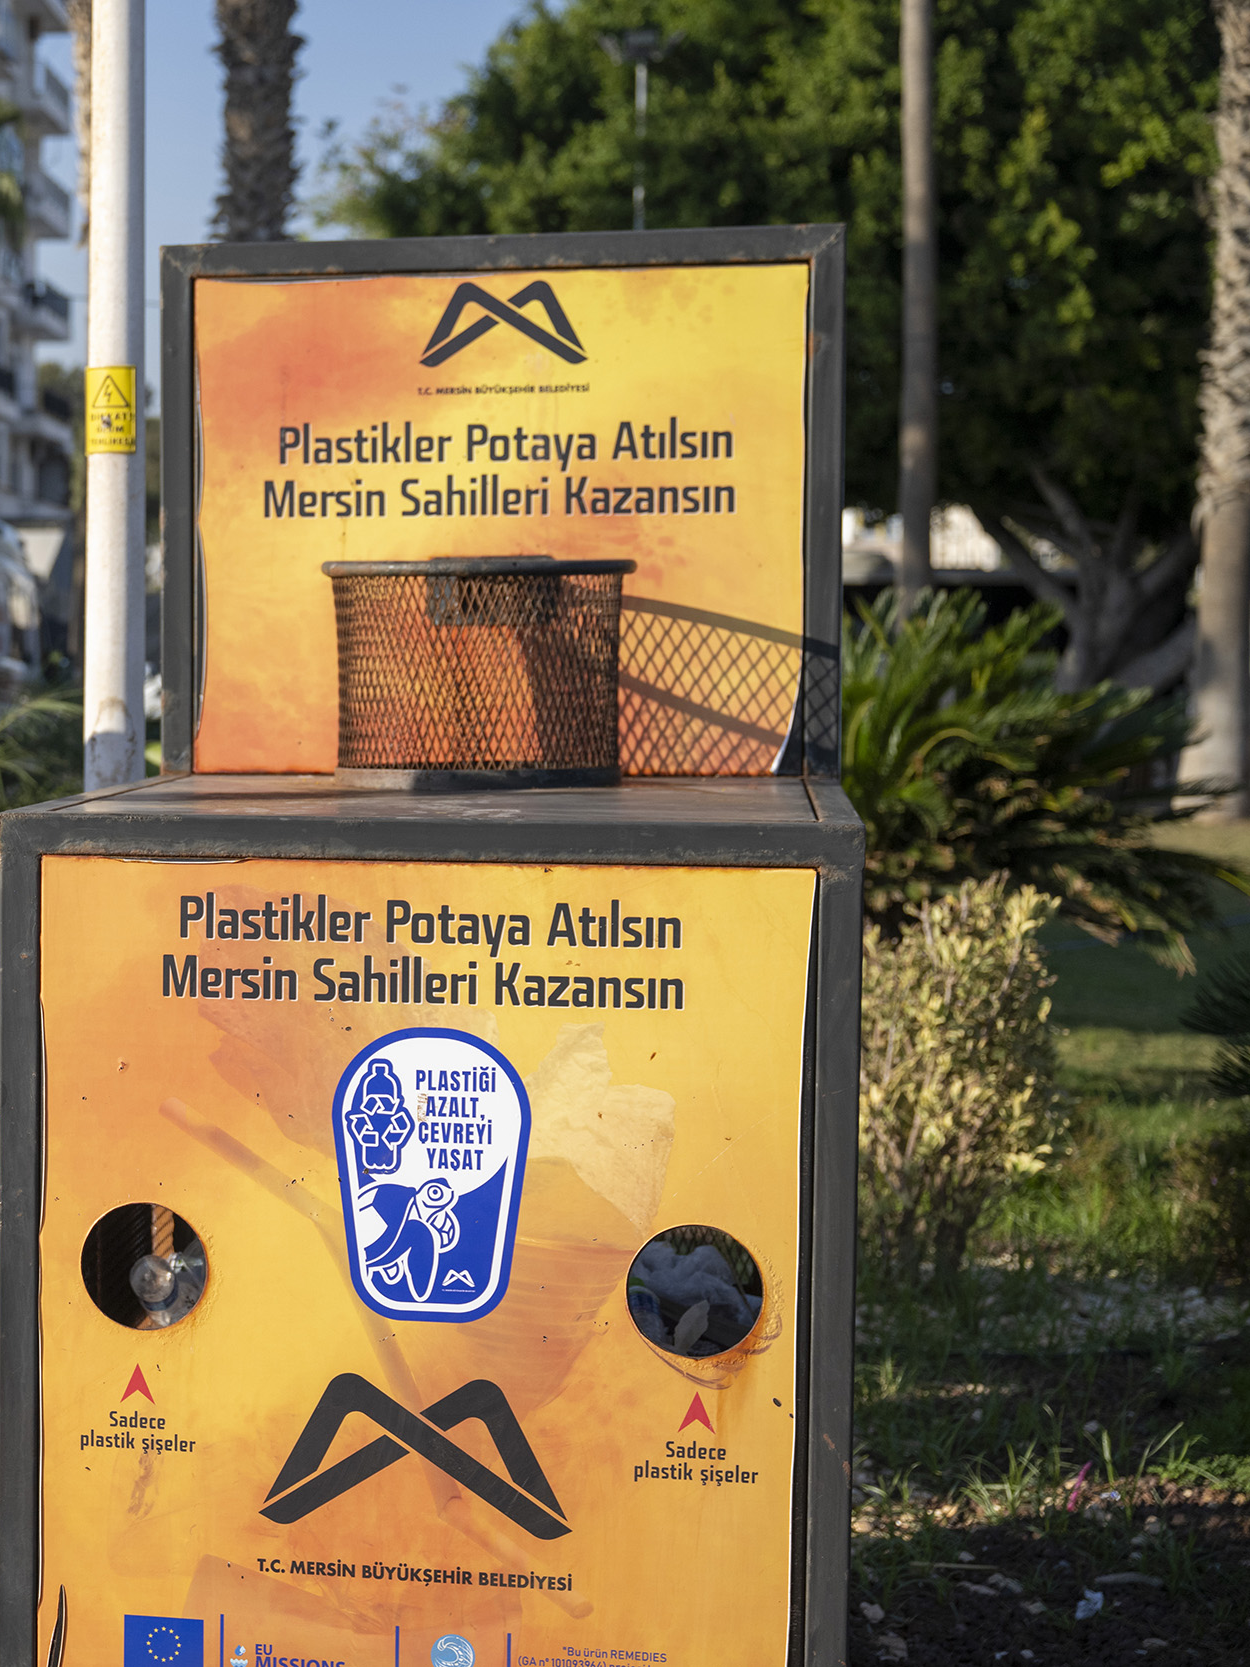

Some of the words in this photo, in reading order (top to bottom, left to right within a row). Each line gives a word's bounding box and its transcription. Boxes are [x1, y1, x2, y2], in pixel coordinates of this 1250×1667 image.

[417, 387, 432, 396] T.C.
[436, 385, 472, 395] MERSİN
[475, 383, 536, 396] BÜYÜKŞEHİR
[538, 381, 590, 393] BELEDİYESİ
[279, 421, 452, 465] Plastikler
[466, 423, 597, 472] Potaya
[611, 416, 734, 461] Atılsın
[263, 478, 386, 518] Mersin
[400, 473, 550, 518] Sahilleri
[564, 475, 736, 516] Kazansın
[179, 891, 372, 944] Plastikler
[386, 899, 531, 958] Potaya
[547, 898, 682, 949] Atılsın
[161, 953, 298, 1001] Mersin
[312, 955, 478, 1005] Sahilleri
[494, 960, 685, 1010] Kazansın
[415, 1066, 497, 1093] PLASTİĞİ
[425, 1096, 486, 1121] AZALT,
[418, 1119, 492, 1145] ÇEVREYİ
[426, 1148, 484, 1171] YAŞAT
[109, 1411, 166, 1430] Sadece
[80, 1429, 135, 1451] plastik
[142, 1433, 196, 1455] şişeler
[665, 1440, 727, 1461] Sadece
[634, 1460, 693, 1482] plastik
[700, 1465, 758, 1487] şişeler
[257, 1558, 285, 1574] T.C.
[290, 1559, 356, 1578] MERSİN
[361, 1561, 473, 1587] BÜYÜKŞEHİR
[478, 1571, 573, 1592] BELEDİYESİ
[255, 1643, 273, 1656] EU
[517, 1655, 537, 1667] (GA
[583, 1647, 608, 1659] ürün
[610, 1649, 668, 1663] REMEDIES
